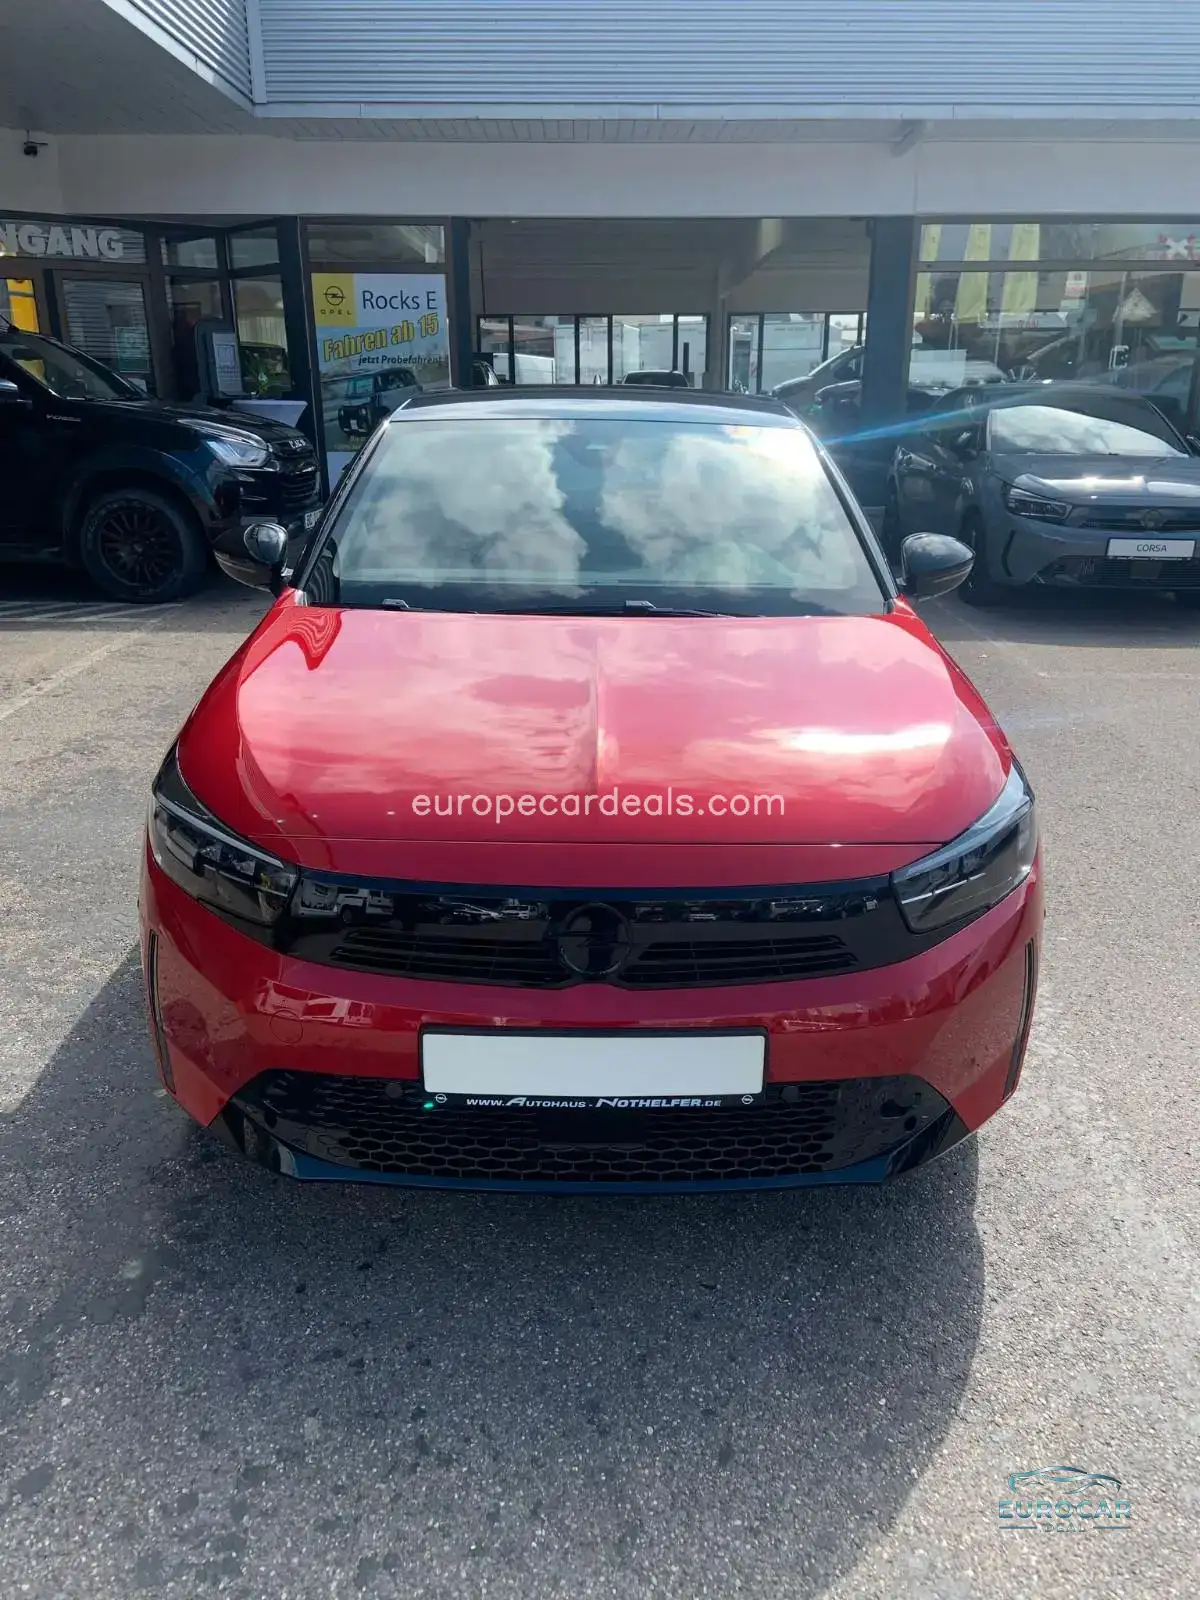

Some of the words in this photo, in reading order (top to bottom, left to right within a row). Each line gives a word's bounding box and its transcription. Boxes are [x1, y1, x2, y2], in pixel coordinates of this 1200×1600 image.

[361, 290, 420, 310] Rocks
[426, 291, 438, 310] E
[323, 328, 388, 362] Fahren
[390, 319, 415, 345] ab
[418, 312, 439, 338] 15
[358, 355, 380, 366] jetzt
[1136, 544, 1167, 552] CORSA
